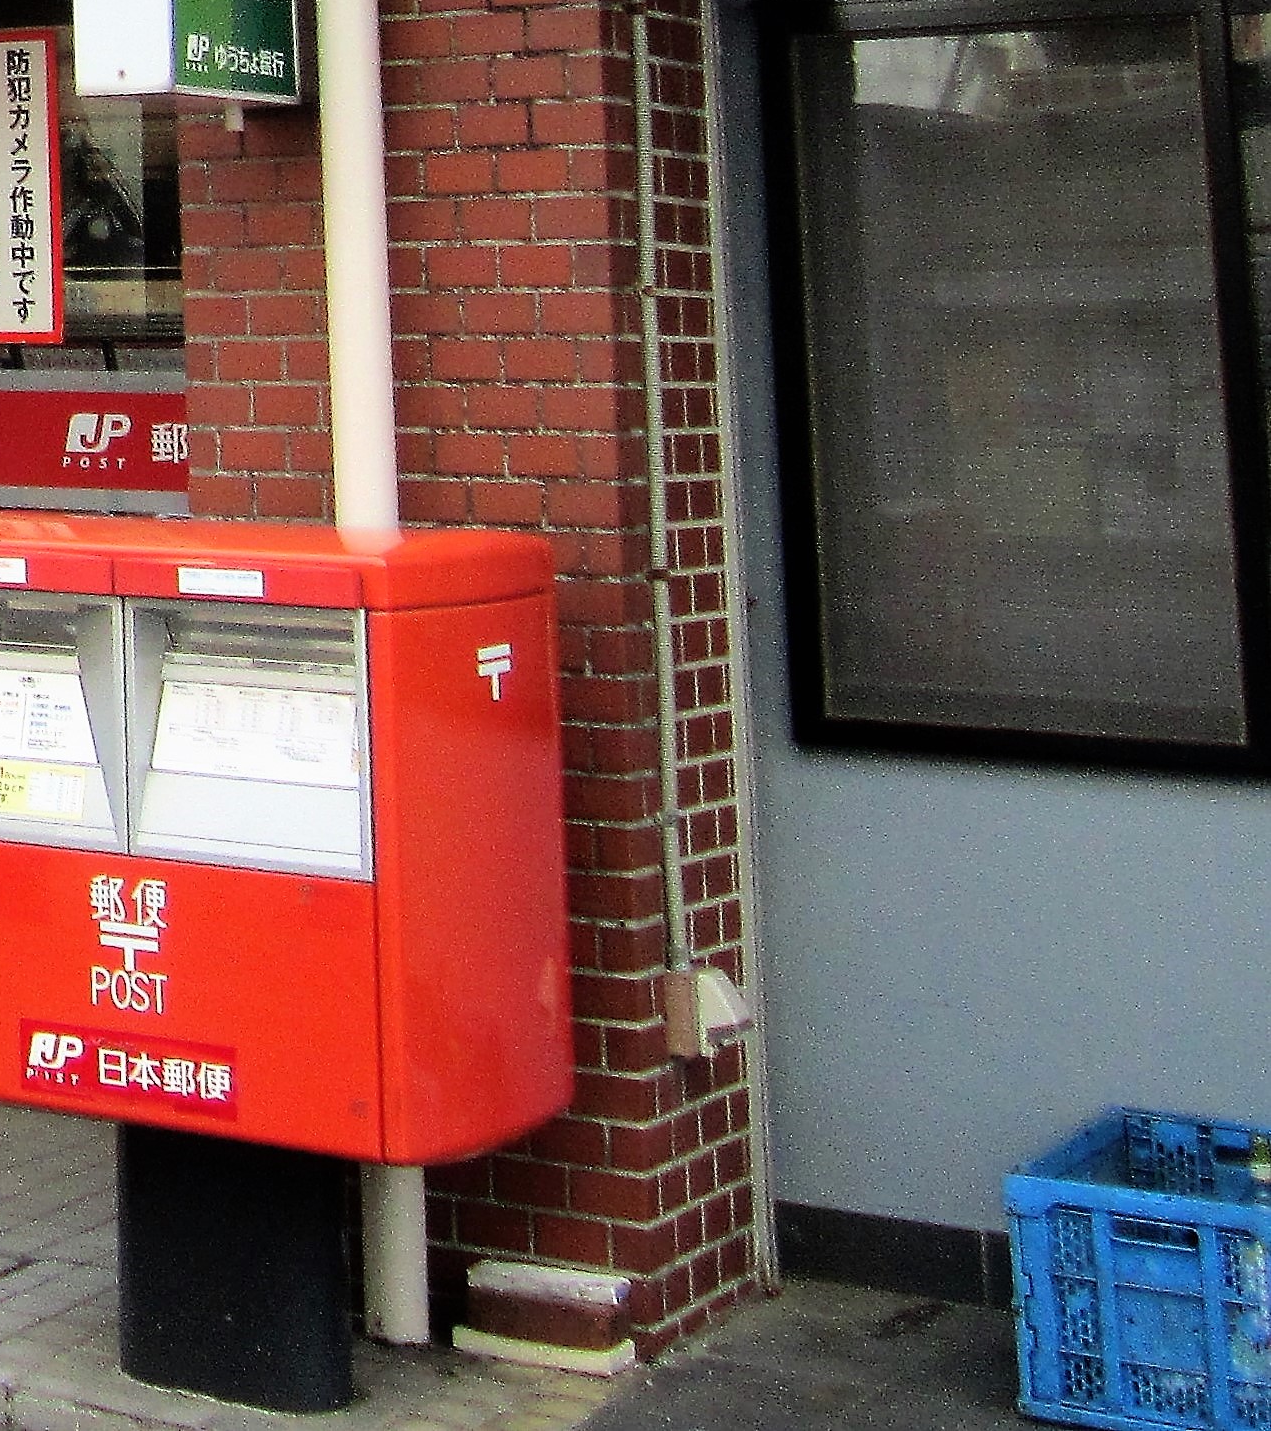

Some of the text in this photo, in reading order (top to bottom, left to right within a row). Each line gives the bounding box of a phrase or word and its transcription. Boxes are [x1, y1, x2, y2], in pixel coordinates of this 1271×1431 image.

[214, 44, 285, 79] ゆうちょ銀行
[6, 47, 37, 325] 防犯カメラ作動中です
[65, 413, 133, 453] JP
[61, 456, 127, 470] POST
[89, 874, 168, 930] 郵便
[90, 965, 169, 1015] POST
[28, 1031, 233, 1102] JP 日本郵便
